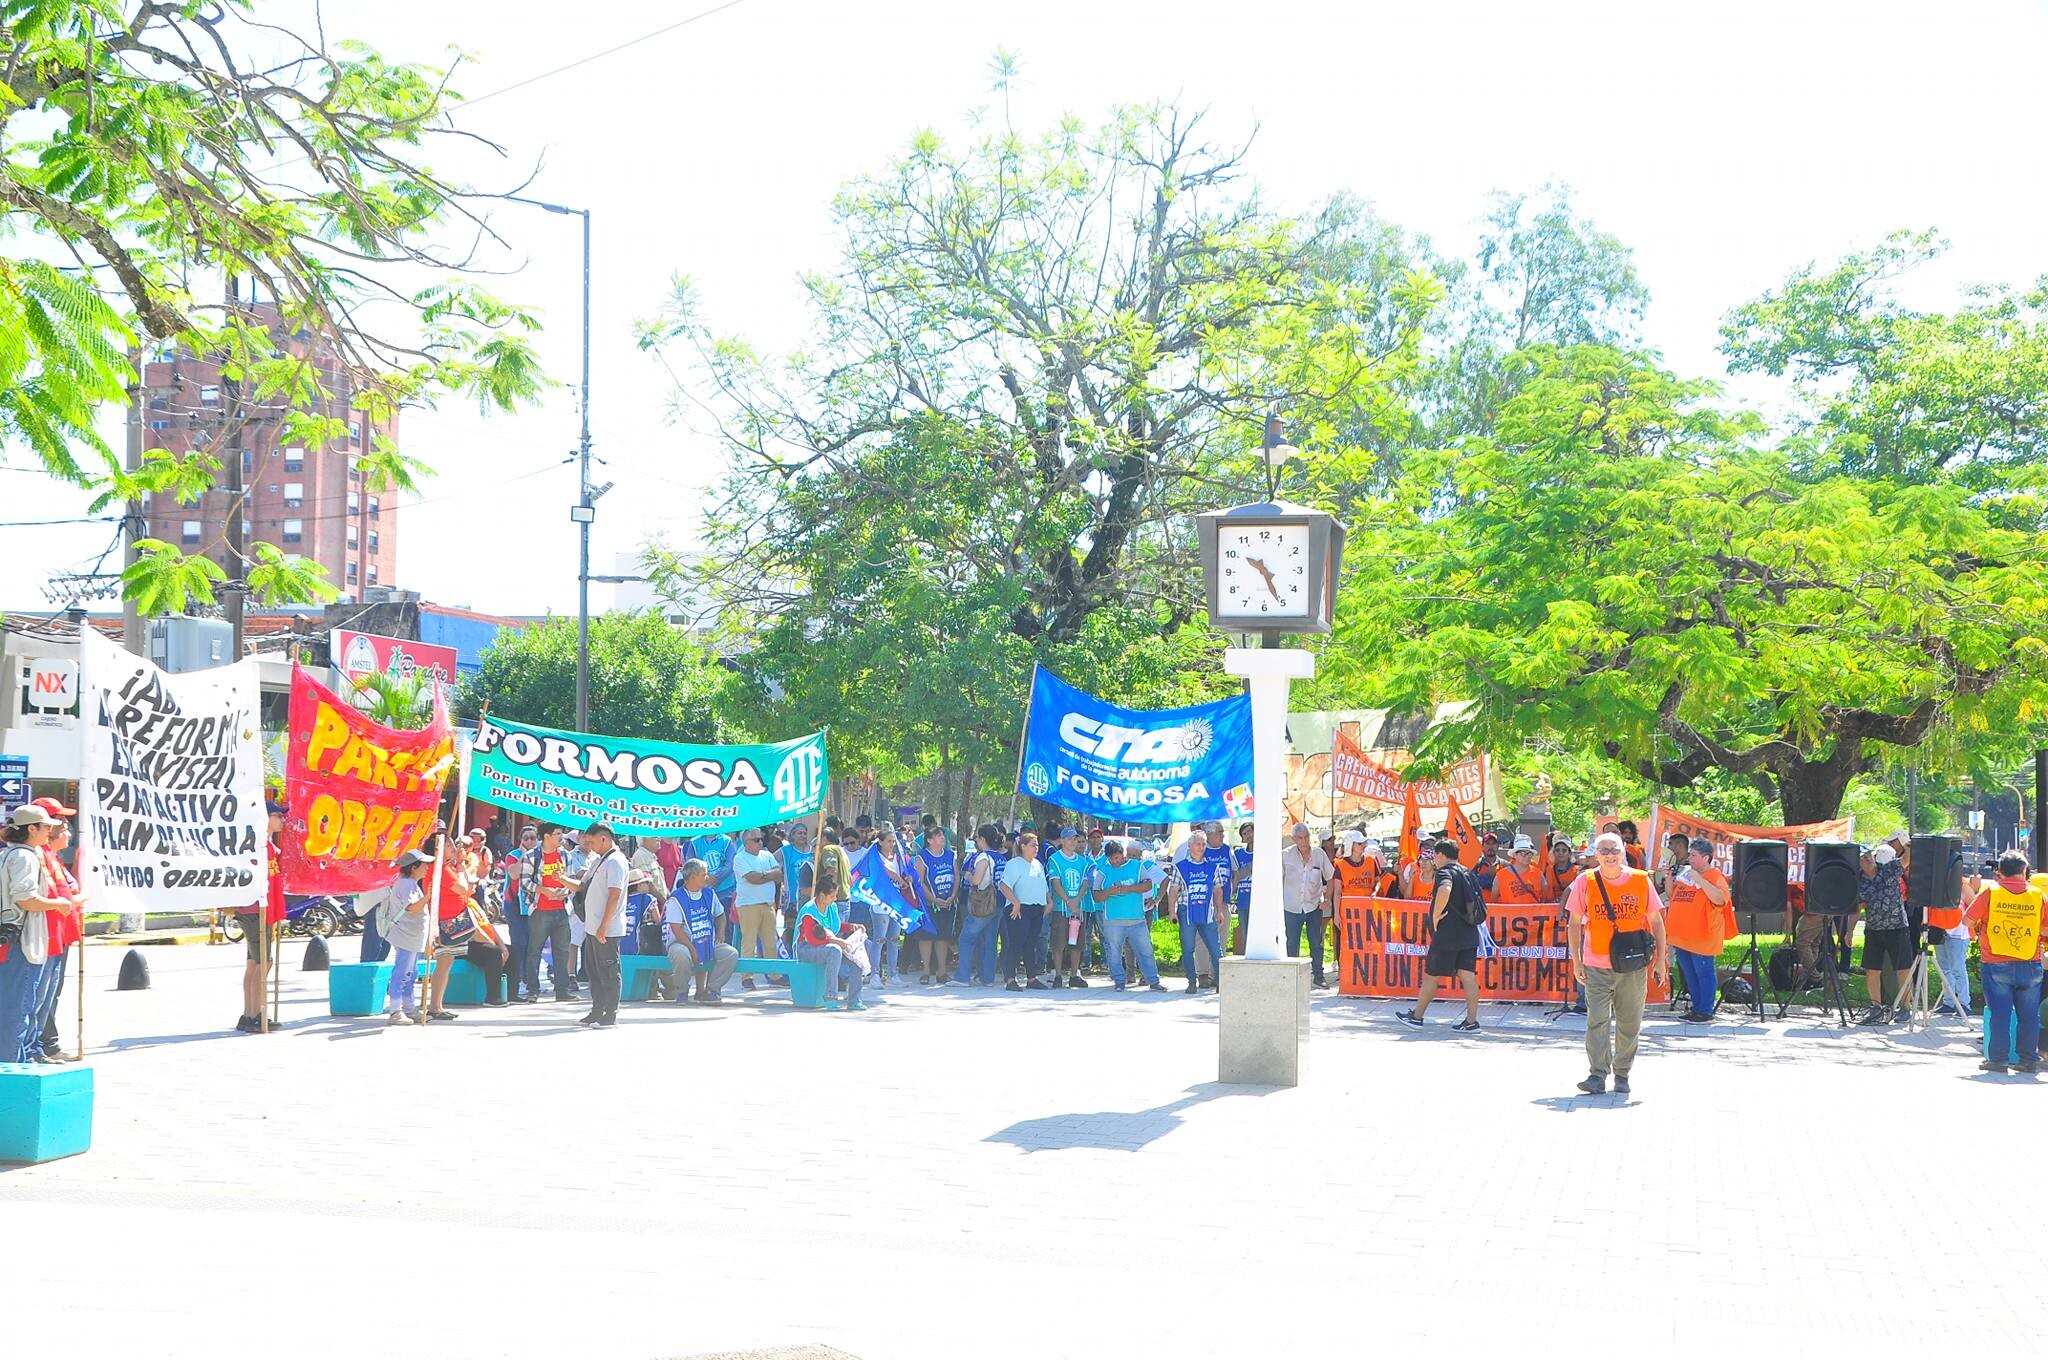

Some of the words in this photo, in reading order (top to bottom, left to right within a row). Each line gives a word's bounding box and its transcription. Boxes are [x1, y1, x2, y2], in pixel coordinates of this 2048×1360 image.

[1258, 531, 1270, 539] 12
[1225, 550, 1236, 558] 10
[1225, 568, 1232, 576] 9
[1229, 586, 1236, 594] 8
[1280, 599, 1286, 607] 5
[351, 659, 373, 671] AMSTEL
[35, 672, 68, 694] NX
[473, 718, 769, 798] FORMOSA
[774, 746, 823, 805] ATE
[1117, 765, 1191, 781] autónoma
[482, 764, 509, 784] Por
[514, 776, 536, 791] un
[541, 781, 604, 806] Estado
[609, 799, 625, 811] al
[631, 804, 706, 818] servicio
[711, 806, 738, 817] del
[1056, 765, 1209, 806] FORMOSA
[1335, 771, 1482, 807] AUTOCONOCADOS
[154, 791, 238, 824] ACTIVO
[491, 787, 549, 809] pueblo
[554, 804, 565, 813] y
[570, 804, 598, 818] los
[602, 812, 721, 829] trabajadores
[98, 817, 154, 852] PLAN
[102, 864, 155, 889] PARTIDO
[162, 866, 253, 889] OBRERO
[1594, 903, 1640, 914] DOENTES
[1996, 902, 2035, 911] ADHERIDO
[1385, 942, 1405, 954] LA
[1500, 946, 1519, 957] ES
[1521, 946, 1543, 958] UN
[1352, 953, 1378, 987] NI
[1385, 954, 1411, 988] UN
